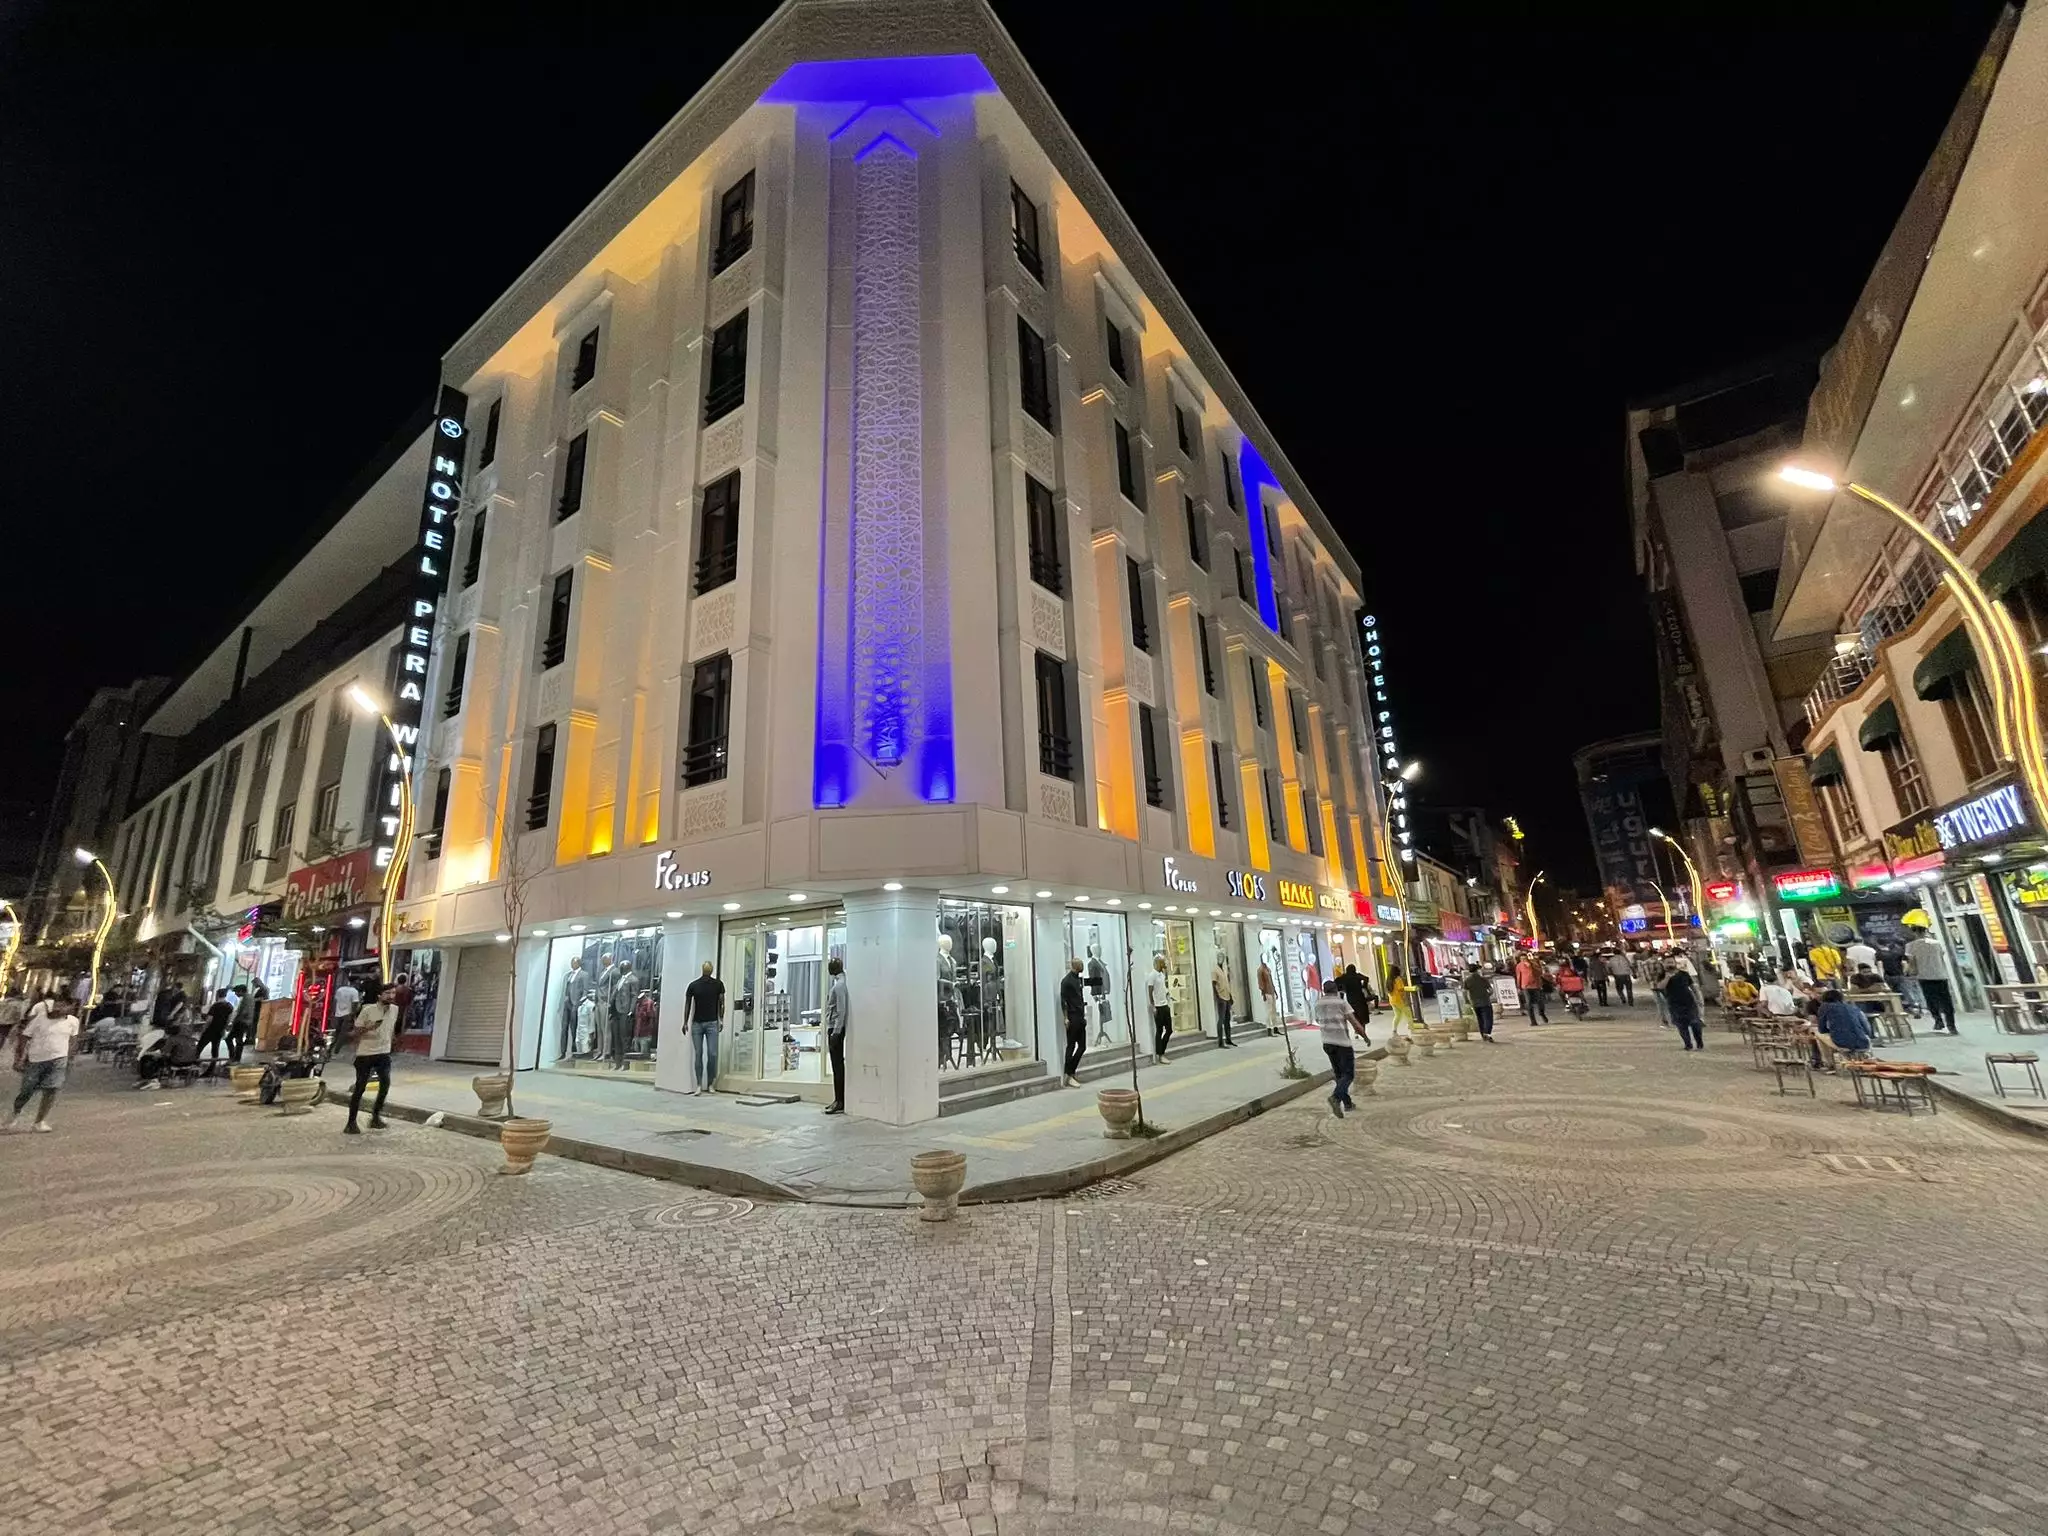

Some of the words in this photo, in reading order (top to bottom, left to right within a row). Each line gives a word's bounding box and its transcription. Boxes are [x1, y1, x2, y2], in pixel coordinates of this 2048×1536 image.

[421, 455, 455, 576] HOTEL
[400, 600, 433, 701] PERA
[1365, 630, 1387, 702] HOTEL
[1379, 711, 1399, 770] PERA
[1950, 785, 2025, 843] TWENTY
[655, 850, 677, 890] FC
[675, 870, 711, 889] PLUS
[1163, 857, 1179, 890] FC
[1227, 870, 1266, 901] SHOES
